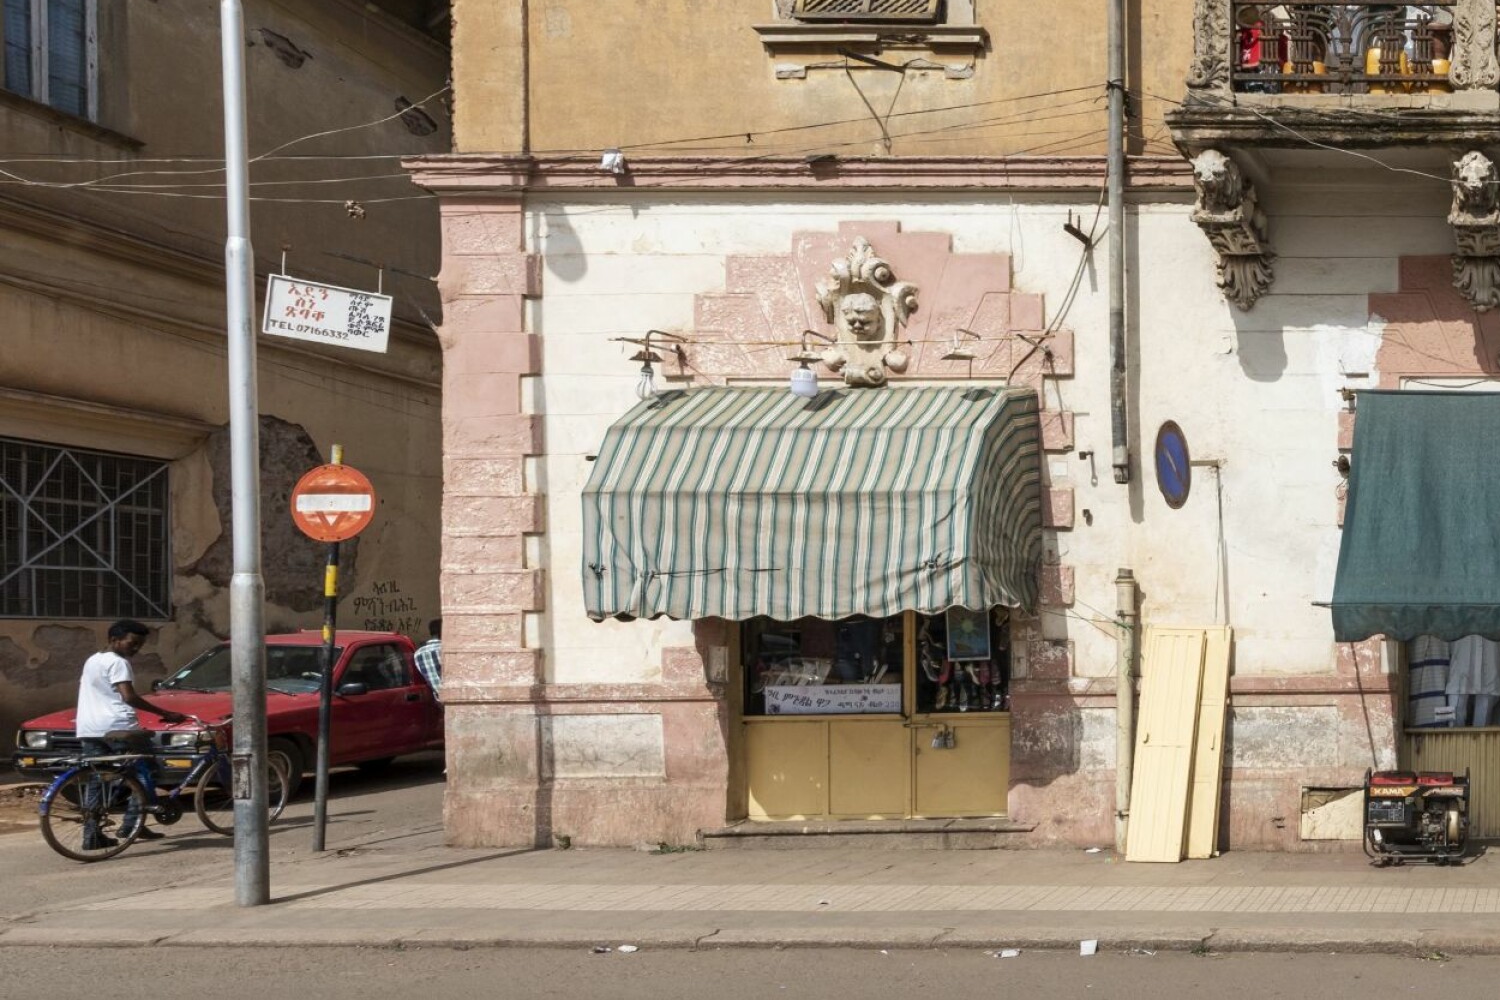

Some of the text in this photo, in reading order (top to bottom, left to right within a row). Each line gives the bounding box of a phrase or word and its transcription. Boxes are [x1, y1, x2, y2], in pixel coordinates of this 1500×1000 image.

[270, 319, 294, 331] TEL
[296, 325, 349, 341] 07166332
[1374, 787, 1404, 795] KAMA
